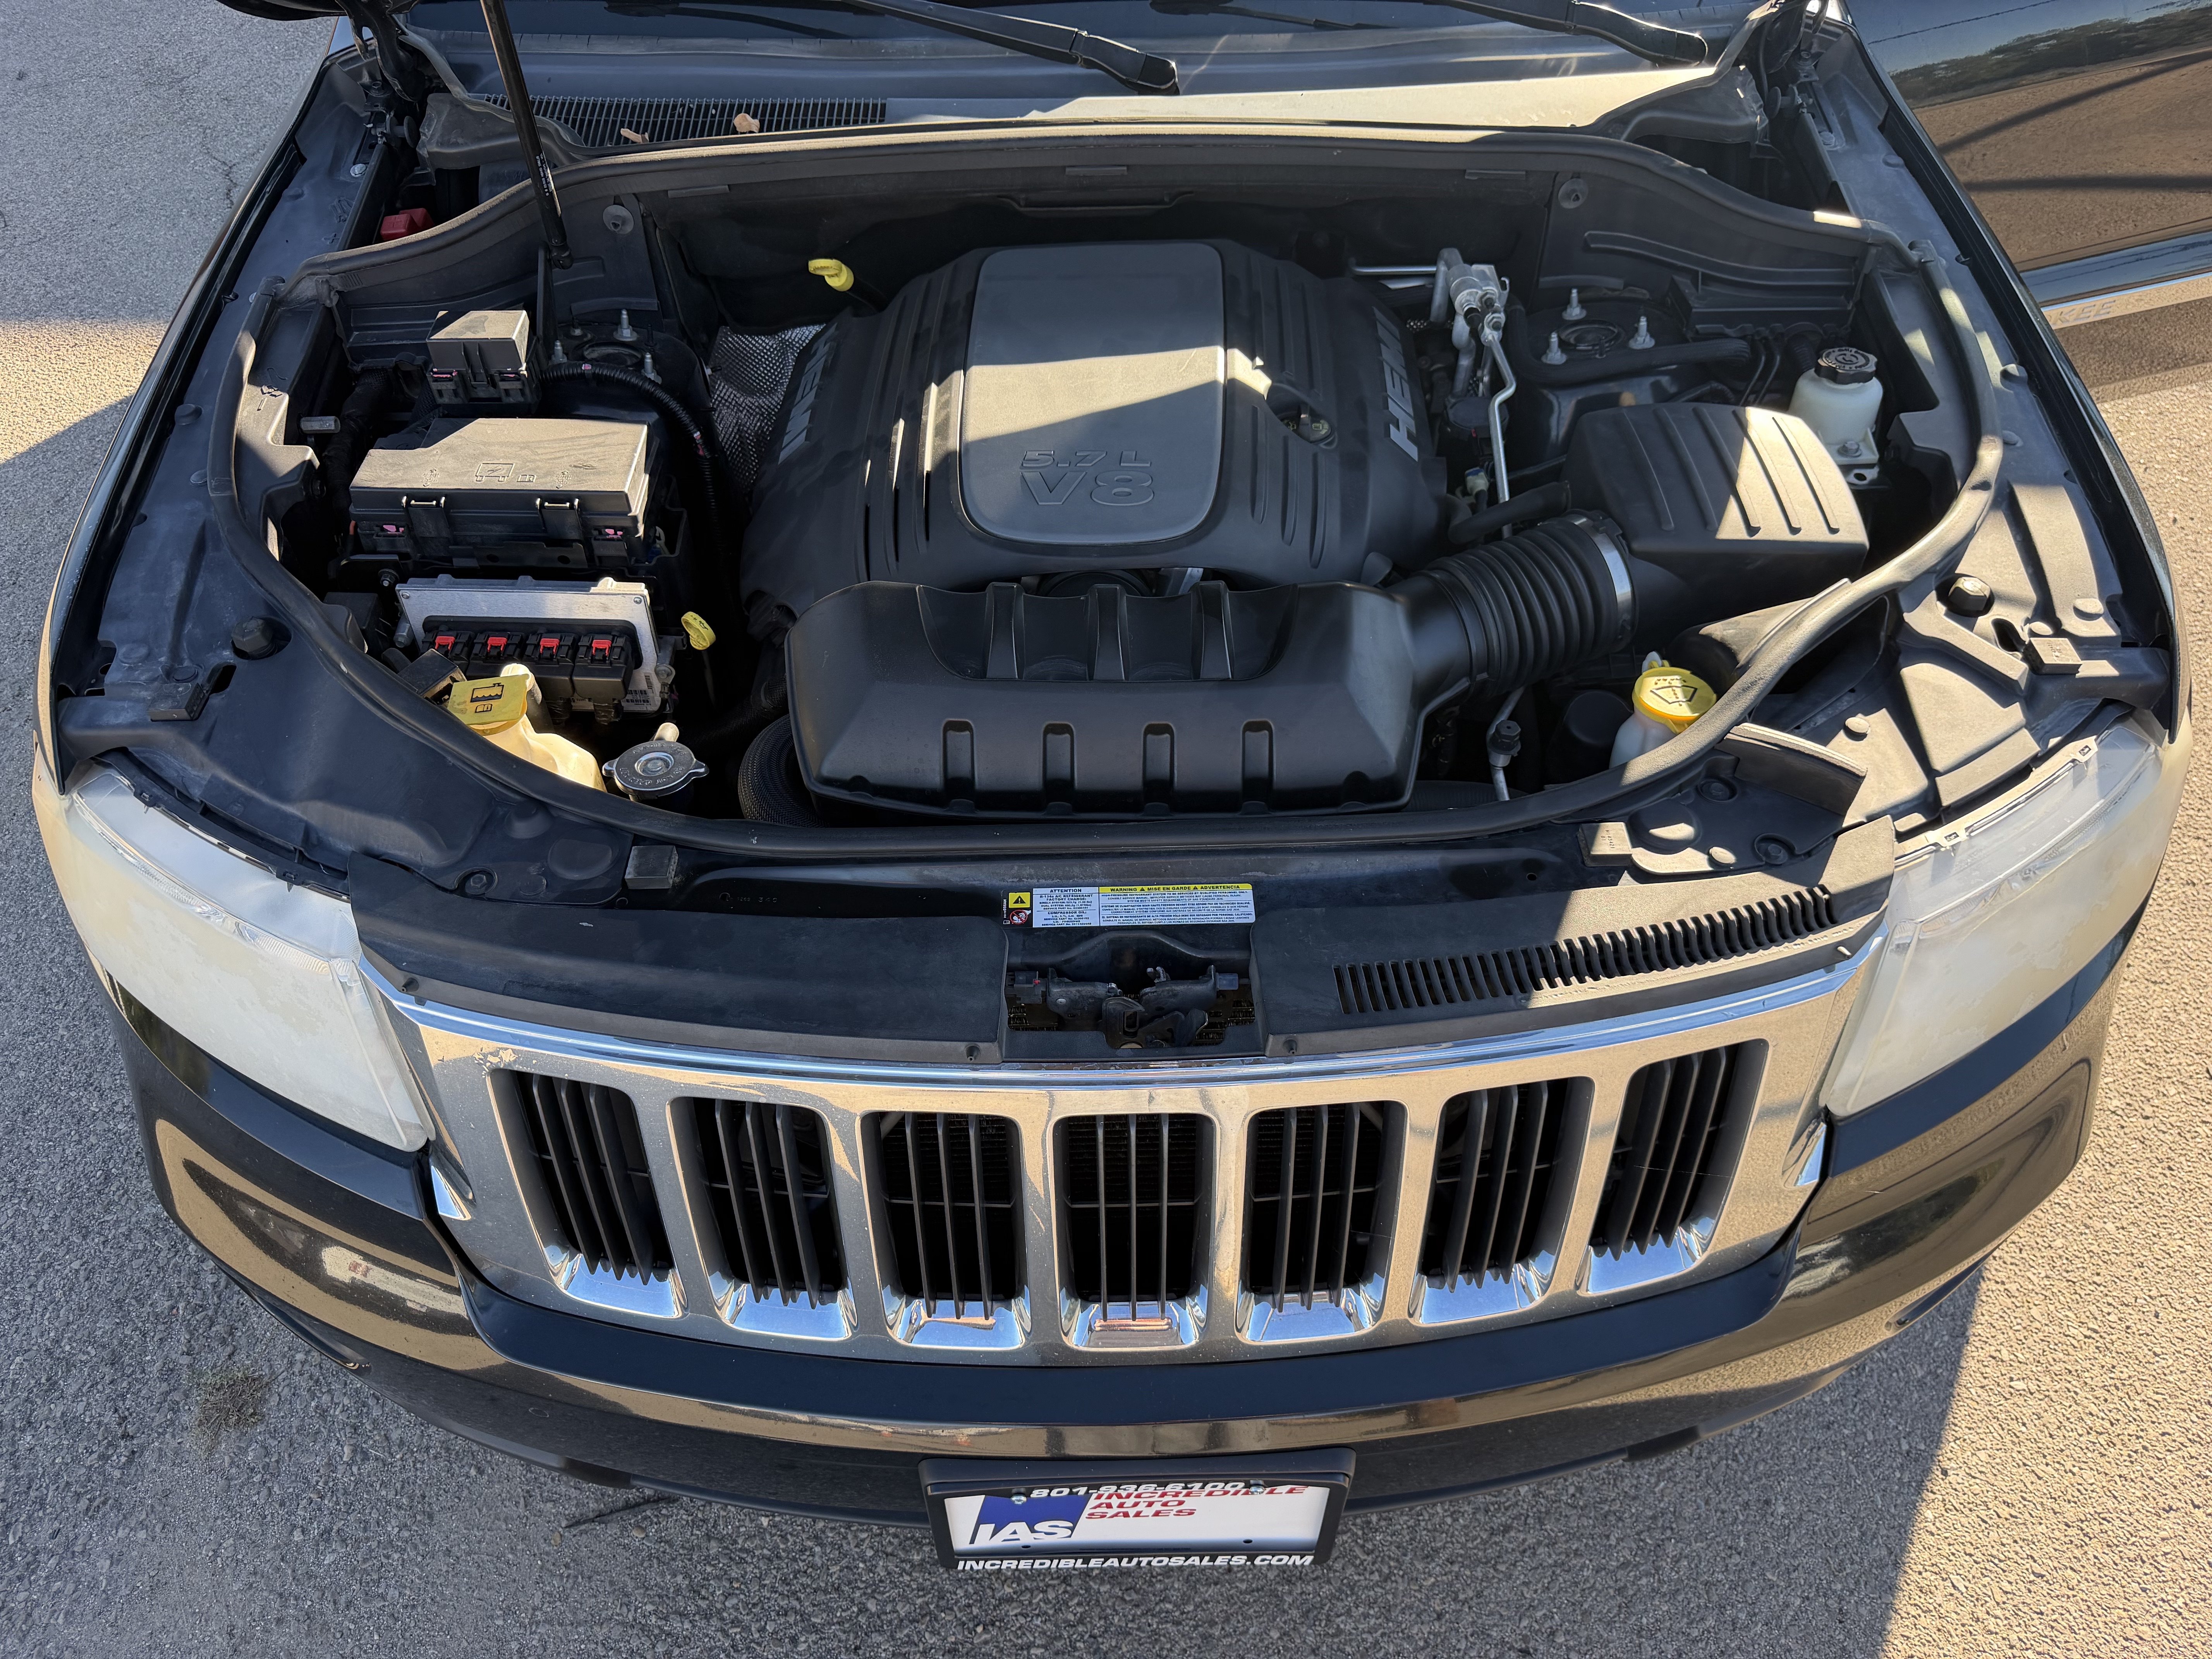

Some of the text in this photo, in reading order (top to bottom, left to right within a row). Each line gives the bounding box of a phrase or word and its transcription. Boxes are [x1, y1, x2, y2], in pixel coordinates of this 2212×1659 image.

[1372, 306, 1419, 462] HEMI
[778, 323, 838, 465] HEMI
[1021, 450, 1152, 467] 5.7 L
[1020, 470, 1155, 506] V8
[1030, 1482, 1245, 1497] 801-936-6100
[1089, 1500, 1185, 1509] AUTO
[1085, 1509, 1197, 1519] SALES
[972, 1520, 1073, 1544] IAS
[957, 1555, 1314, 1570] INCREDIBLEAUTOSALES.COM
